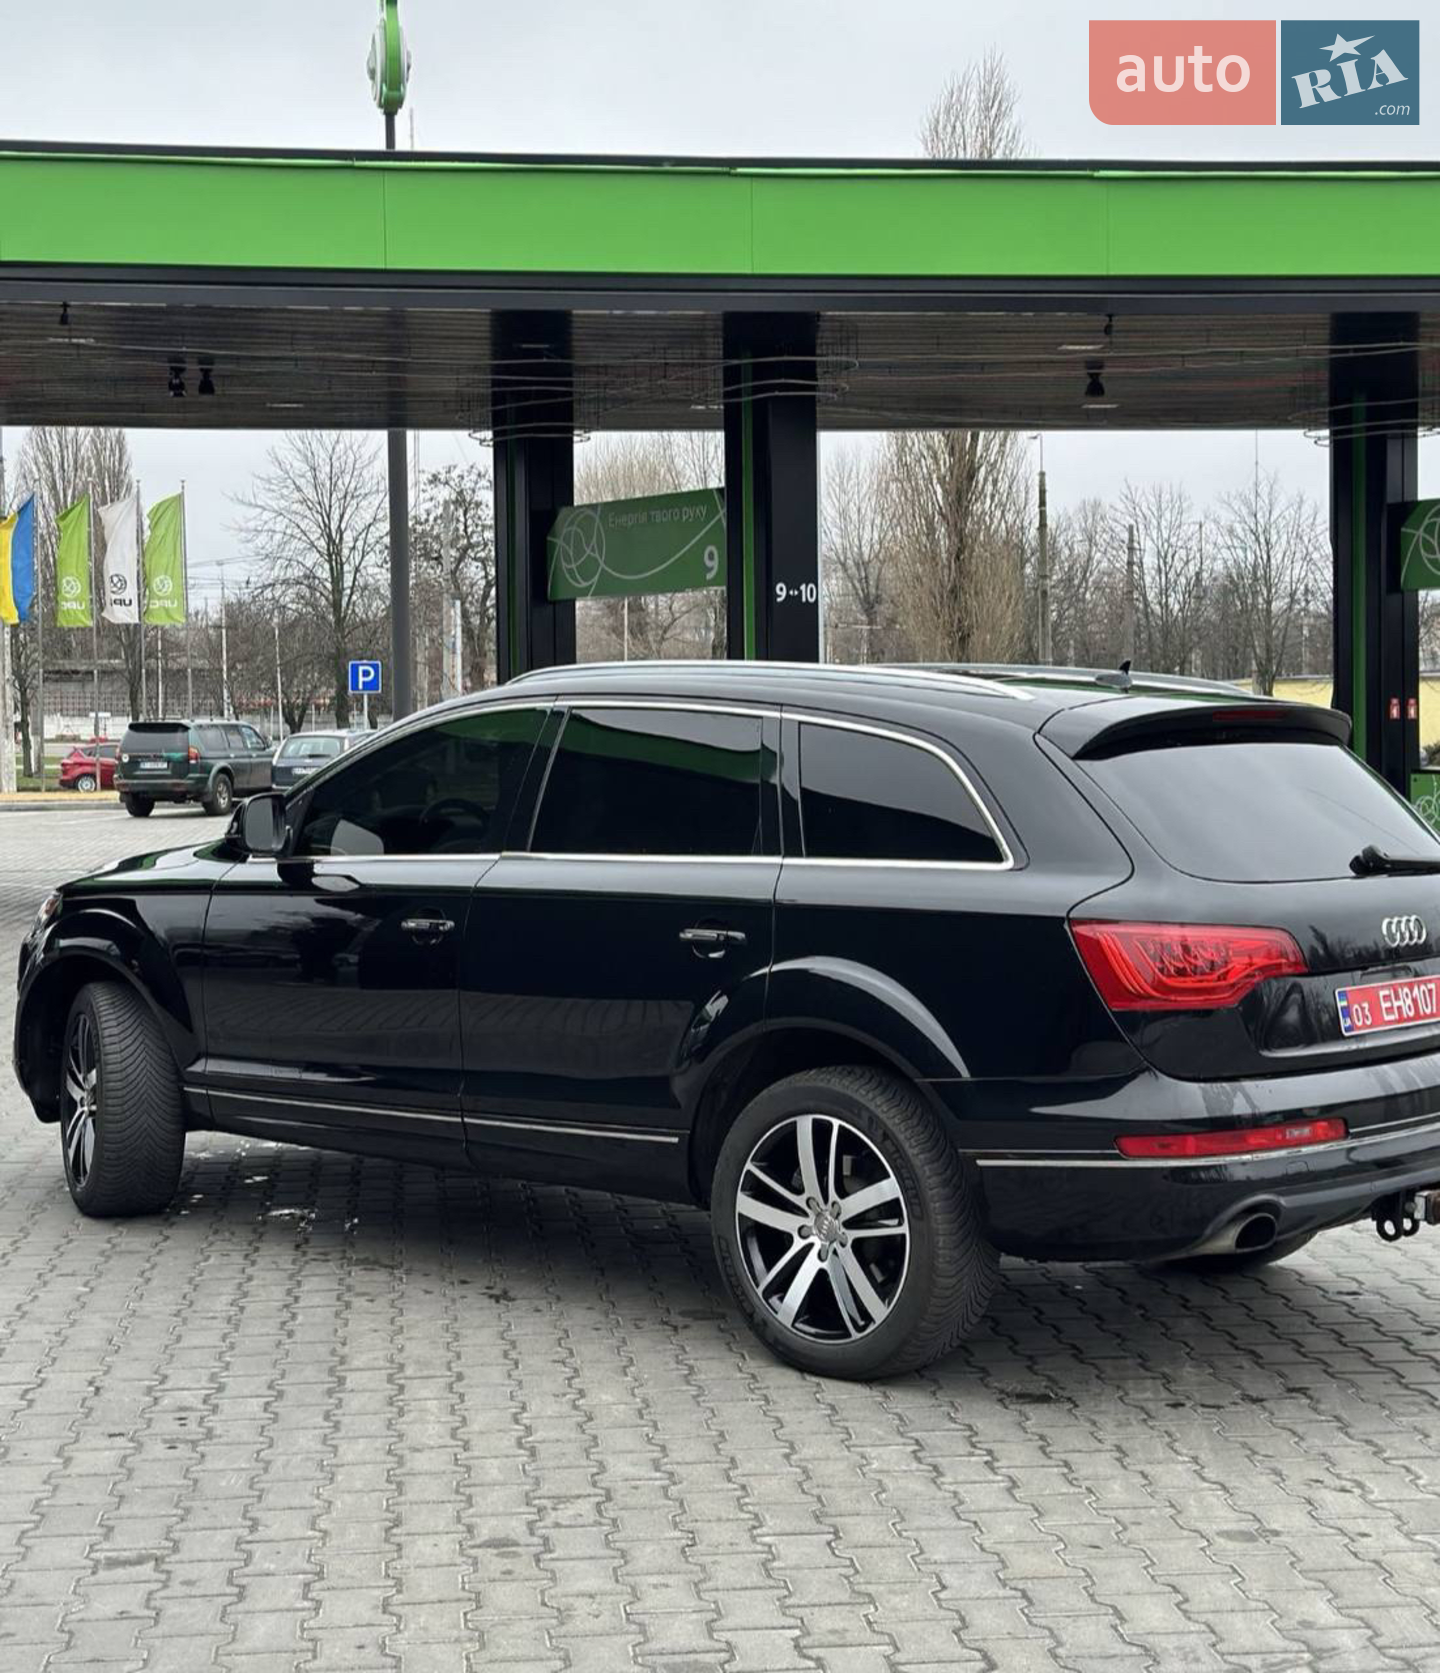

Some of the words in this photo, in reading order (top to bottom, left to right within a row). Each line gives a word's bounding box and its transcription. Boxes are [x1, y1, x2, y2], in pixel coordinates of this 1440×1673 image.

[650, 507, 680, 523] твого
[682, 504, 708, 523] руху
[703, 545, 719, 581] 9
[775, 582, 788, 603] 9
[799, 583, 817, 604] 10
[358, 665, 375, 691] P
[1352, 1001, 1372, 1027] 03
[1379, 982, 1436, 1022] EH8107
